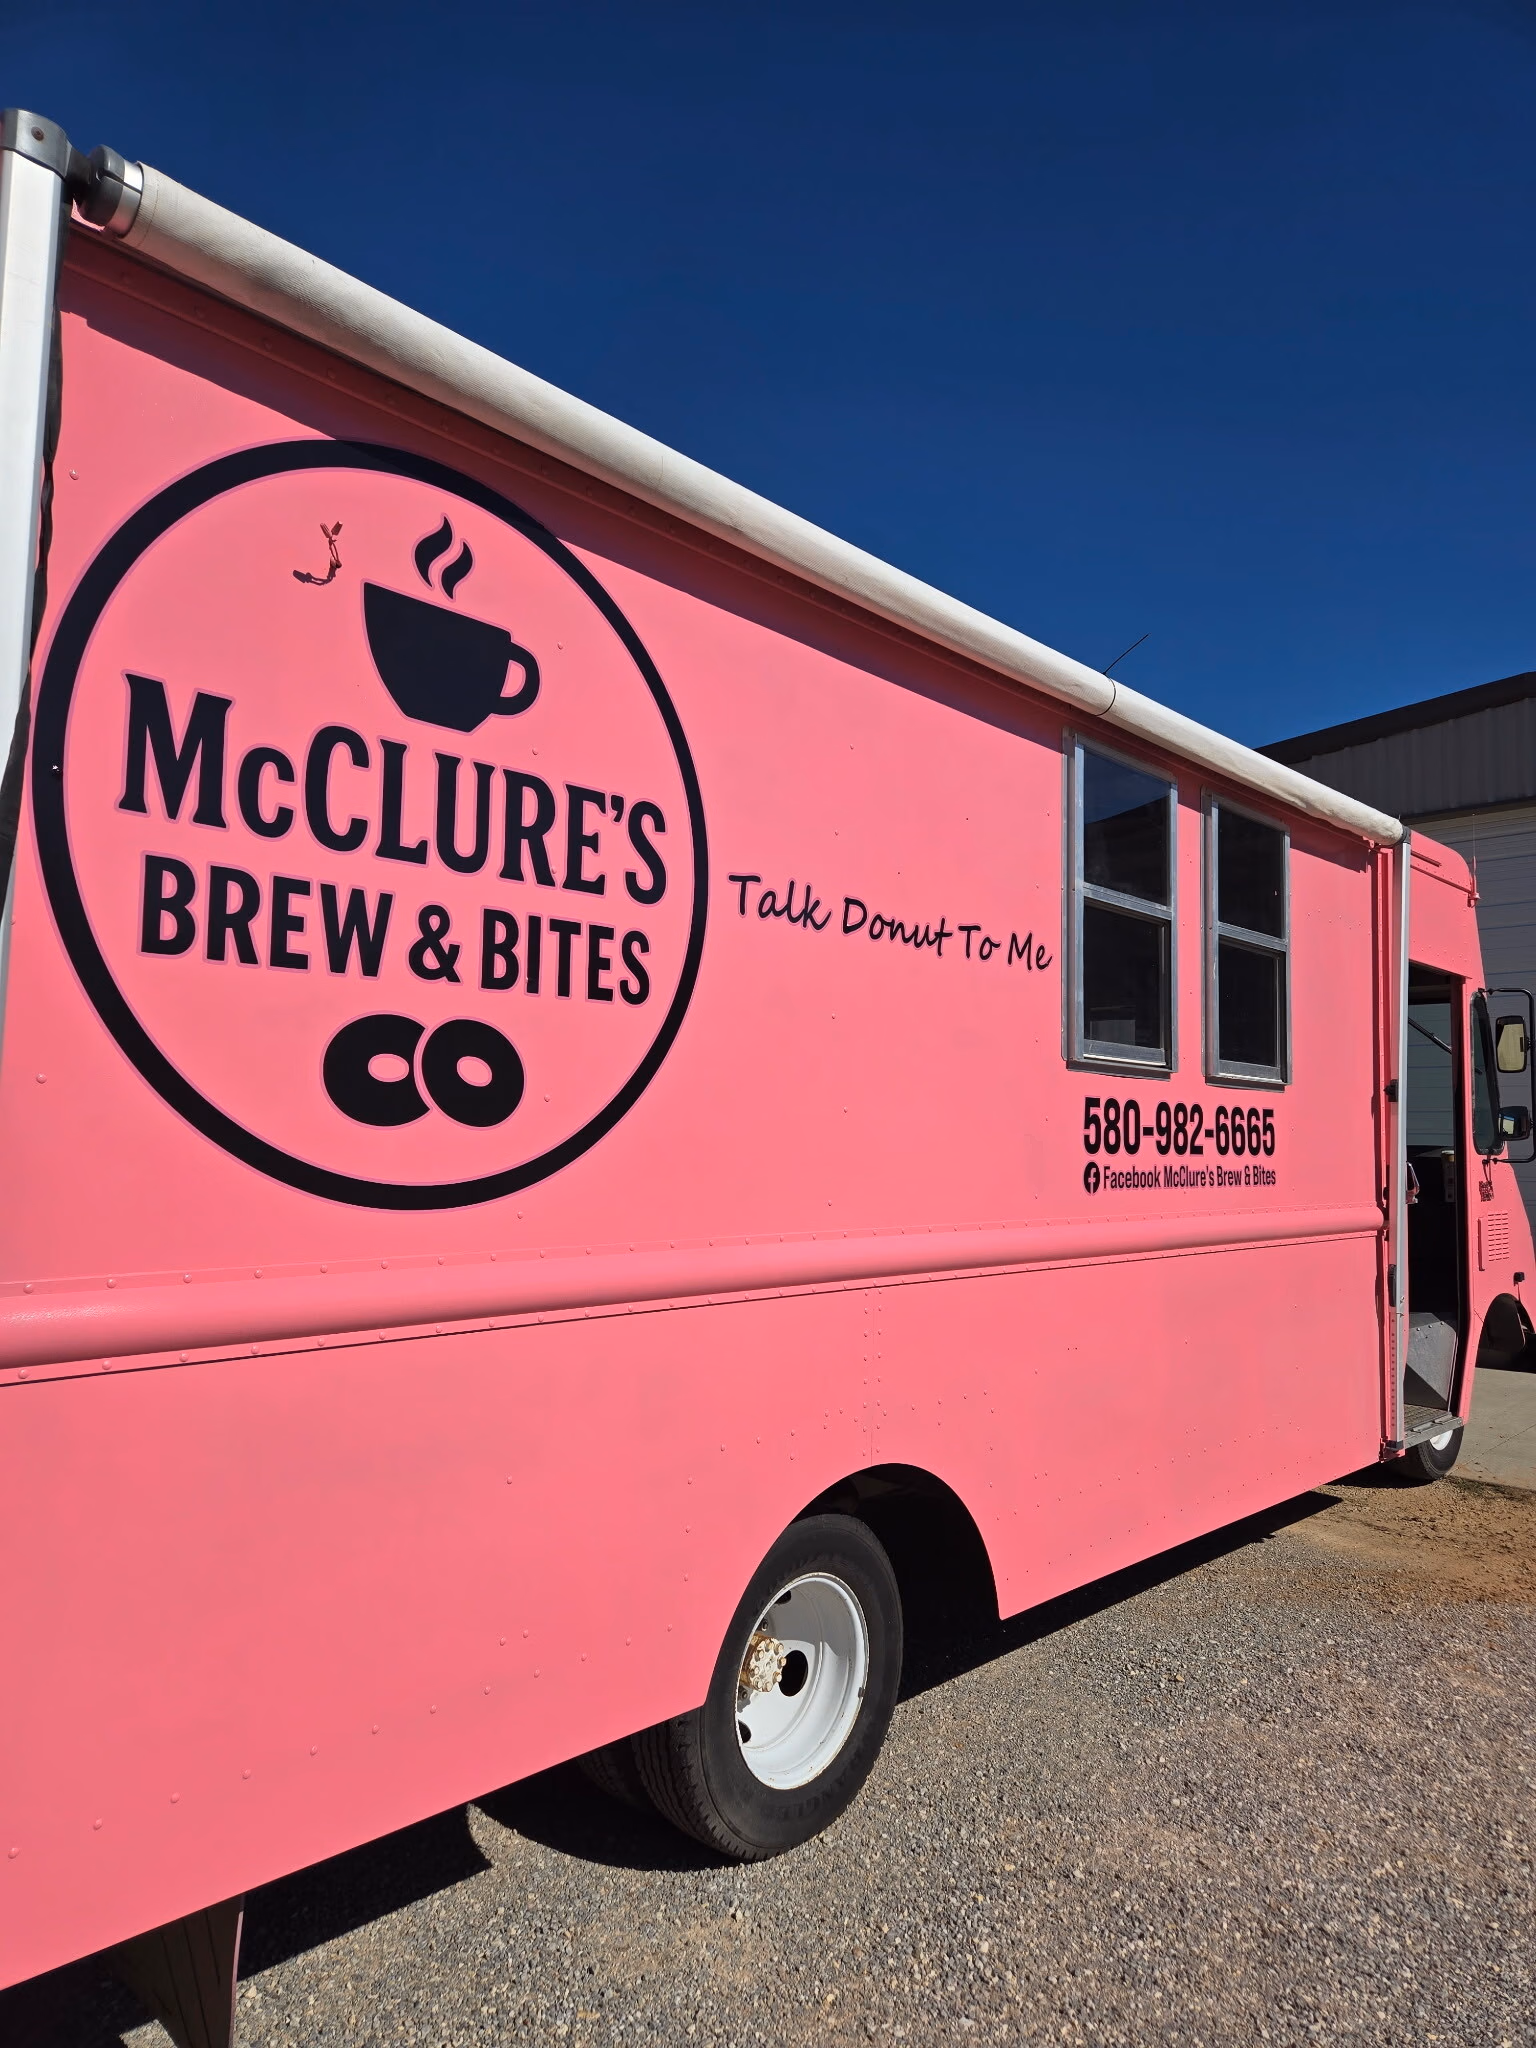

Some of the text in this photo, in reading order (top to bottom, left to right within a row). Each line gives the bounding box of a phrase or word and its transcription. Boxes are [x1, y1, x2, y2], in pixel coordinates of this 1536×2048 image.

[119, 673, 667, 904] McCLURE'S
[141, 855, 651, 1005] BREW & BITES
[728, 874, 1053, 971] Talk Donut To Me
[1083, 1096, 1275, 1156] 580-982-6665
[1103, 1165, 1161, 1189] Facebook
[1163, 1165, 1215, 1188] McClure's
[1216, 1165, 1242, 1187] Brew
[1244, 1165, 1251, 1186] &
[1252, 1165, 1276, 1186] Bites
